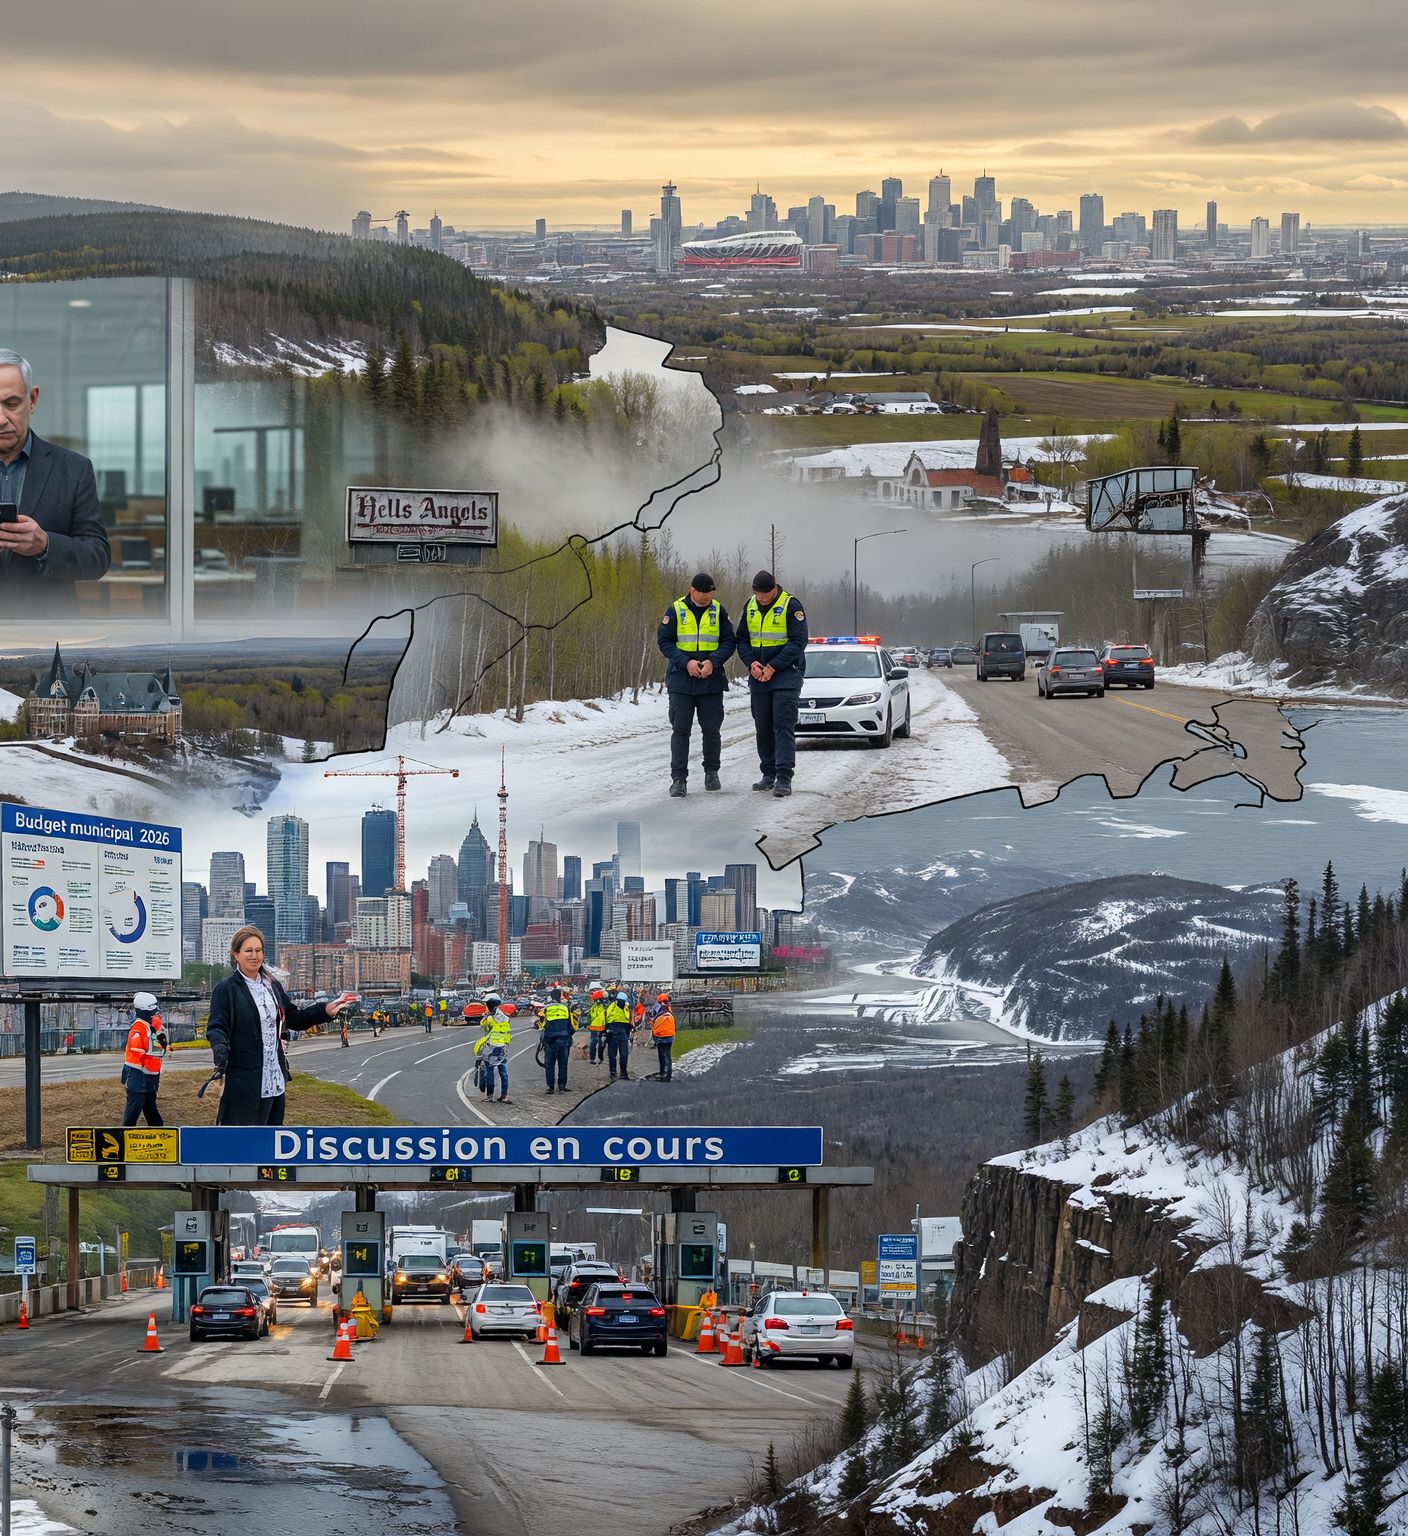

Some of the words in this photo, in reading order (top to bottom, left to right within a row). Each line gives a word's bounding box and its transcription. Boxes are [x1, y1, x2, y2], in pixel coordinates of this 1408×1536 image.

[356, 495, 412, 523] Hells
[420, 496, 488, 526] Angels
[15, 811, 67, 833] Budget
[70, 821, 134, 843] municipal
[139, 828, 170, 846] 2026
[274, 1129, 507, 1161] Discussion
[530, 1136, 581, 1161] en
[603, 1136, 724, 1161] cours
